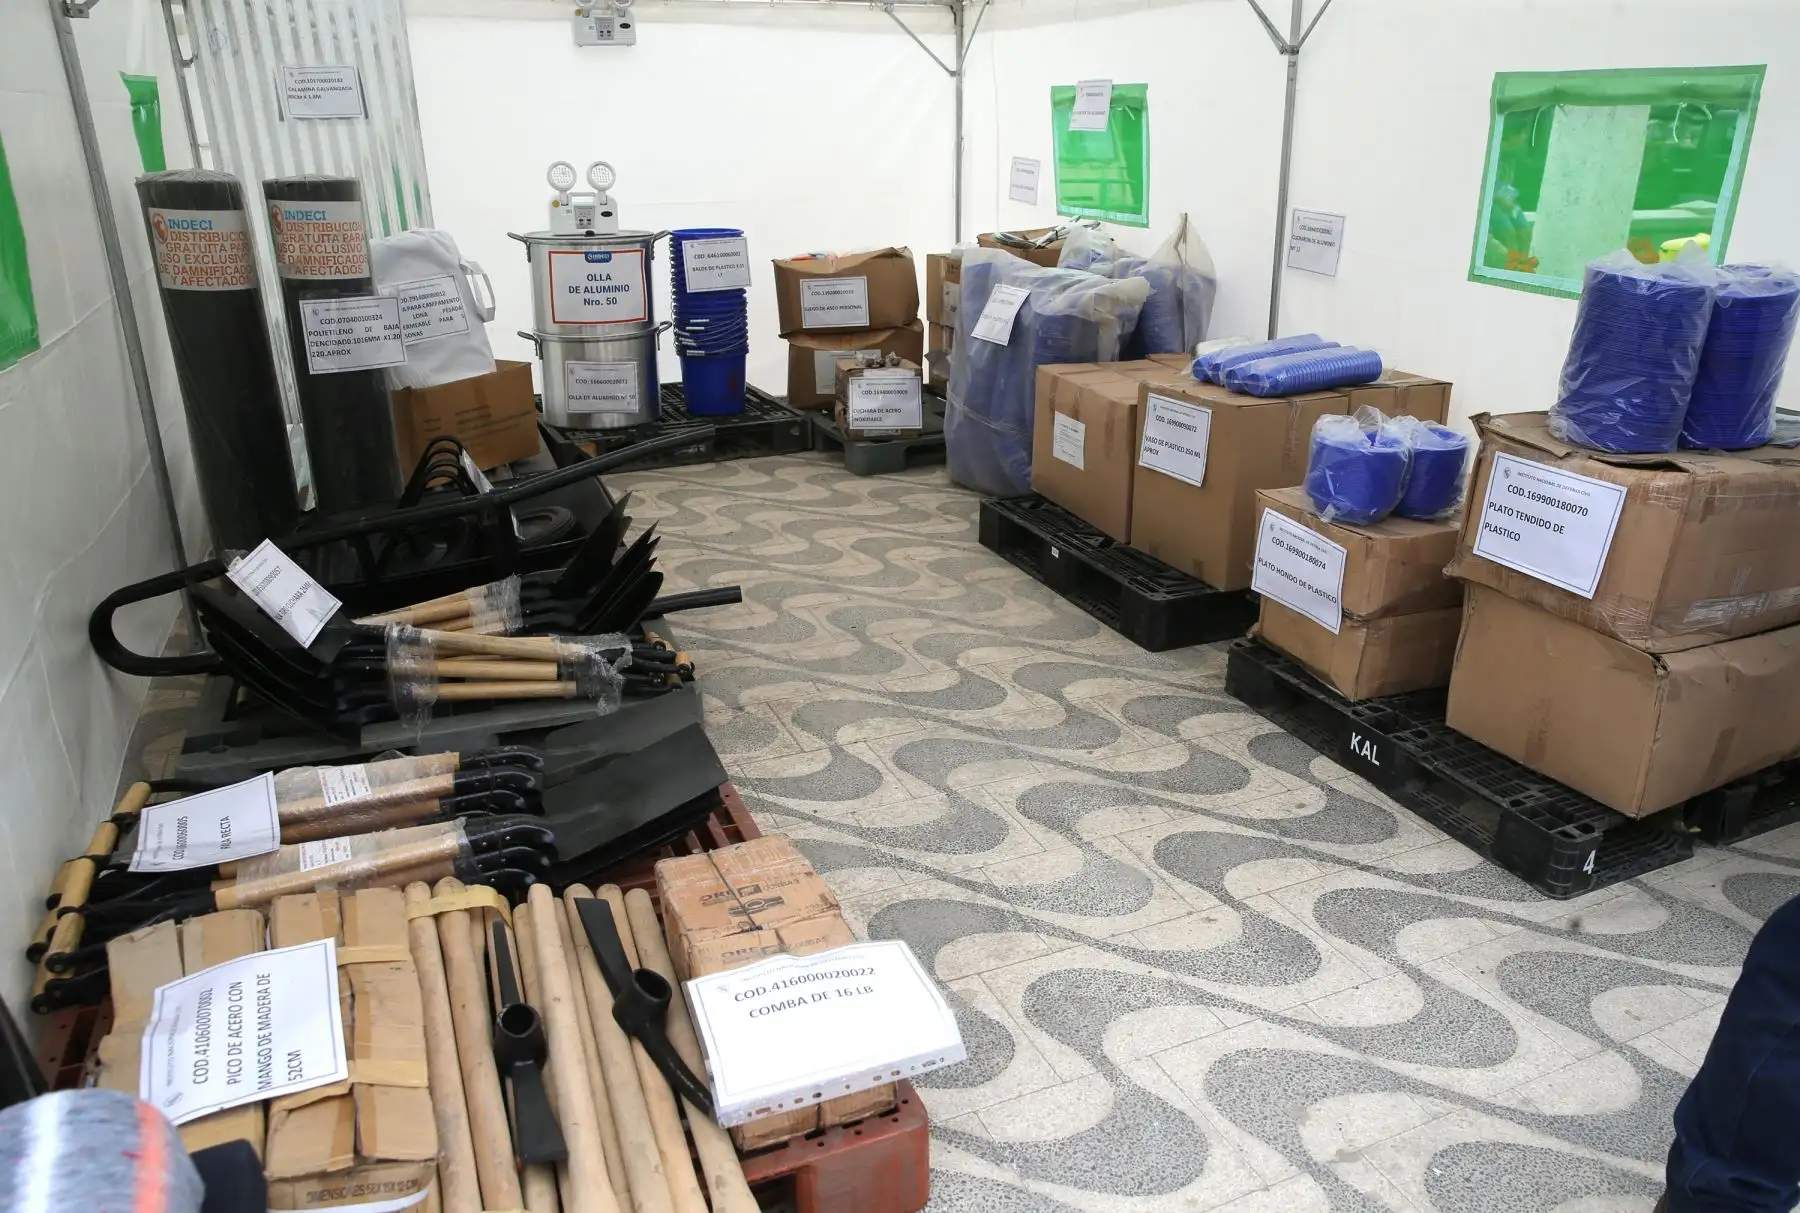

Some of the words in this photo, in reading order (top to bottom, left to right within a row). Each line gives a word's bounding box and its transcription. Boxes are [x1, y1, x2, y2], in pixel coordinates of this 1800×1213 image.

[168, 218, 214, 230] INDECI
[284, 210, 327, 220] INDECI
[282, 233, 340, 243] GRATUITA
[166, 242, 227, 254] GRATUITA
[230, 243, 250, 254] PAR
[299, 244, 362, 254] EXCLUSIVO
[160, 264, 170, 274] DE
[295, 264, 364, 276] AFECTADOS
[586, 274, 612, 282] OLLA
[584, 284, 630, 294] ALUMINIO
[606, 297, 617, 305] 50
[308, 328, 354, 336] POLIETILENO
[312, 349, 352, 358] 220.APROX
[1156, 415, 1166, 423] COD.
[1146, 436, 1157, 444] VASO
[1165, 441, 1185, 453] PLASTICO
[1185, 448, 1193, 456] 250
[1507, 484, 1589, 517] COD.169900180070
[1489, 501, 1514, 517] PLATO
[1516, 510, 1551, 530] TENDIDO
[1553, 523, 1565, 535] DE
[1485, 522, 1521, 542] PLASTICO
[1259, 557, 1275, 572] PLATO
[1276, 568, 1298, 584] HONDO
[1298, 579, 1307, 589] DE
[1307, 584, 1337, 604] PLASTICO
[1350, 732, 1380, 766] KAL
[220, 816, 232, 838] RECTA
[1583, 850, 1596, 875] 4
[257, 972, 271, 988] DE
[734, 967, 877, 1002] COD.416000020022
[229, 981, 243, 1002] CON
[749, 996, 808, 1018] COMBA
[811, 991, 832, 1003] DE
[836, 988, 853, 998] 16
[857, 985, 874, 994] LB
[257, 992, 273, 1031] MADERA
[228, 1004, 243, 1042] ACERO
[257, 1032, 272, 1047] DE
[228, 1043, 242, 1056] DE
[226, 1058, 242, 1086] PICO
[257, 1049, 273, 1090] MANGO
[287, 1048, 303, 1082] 52CM
